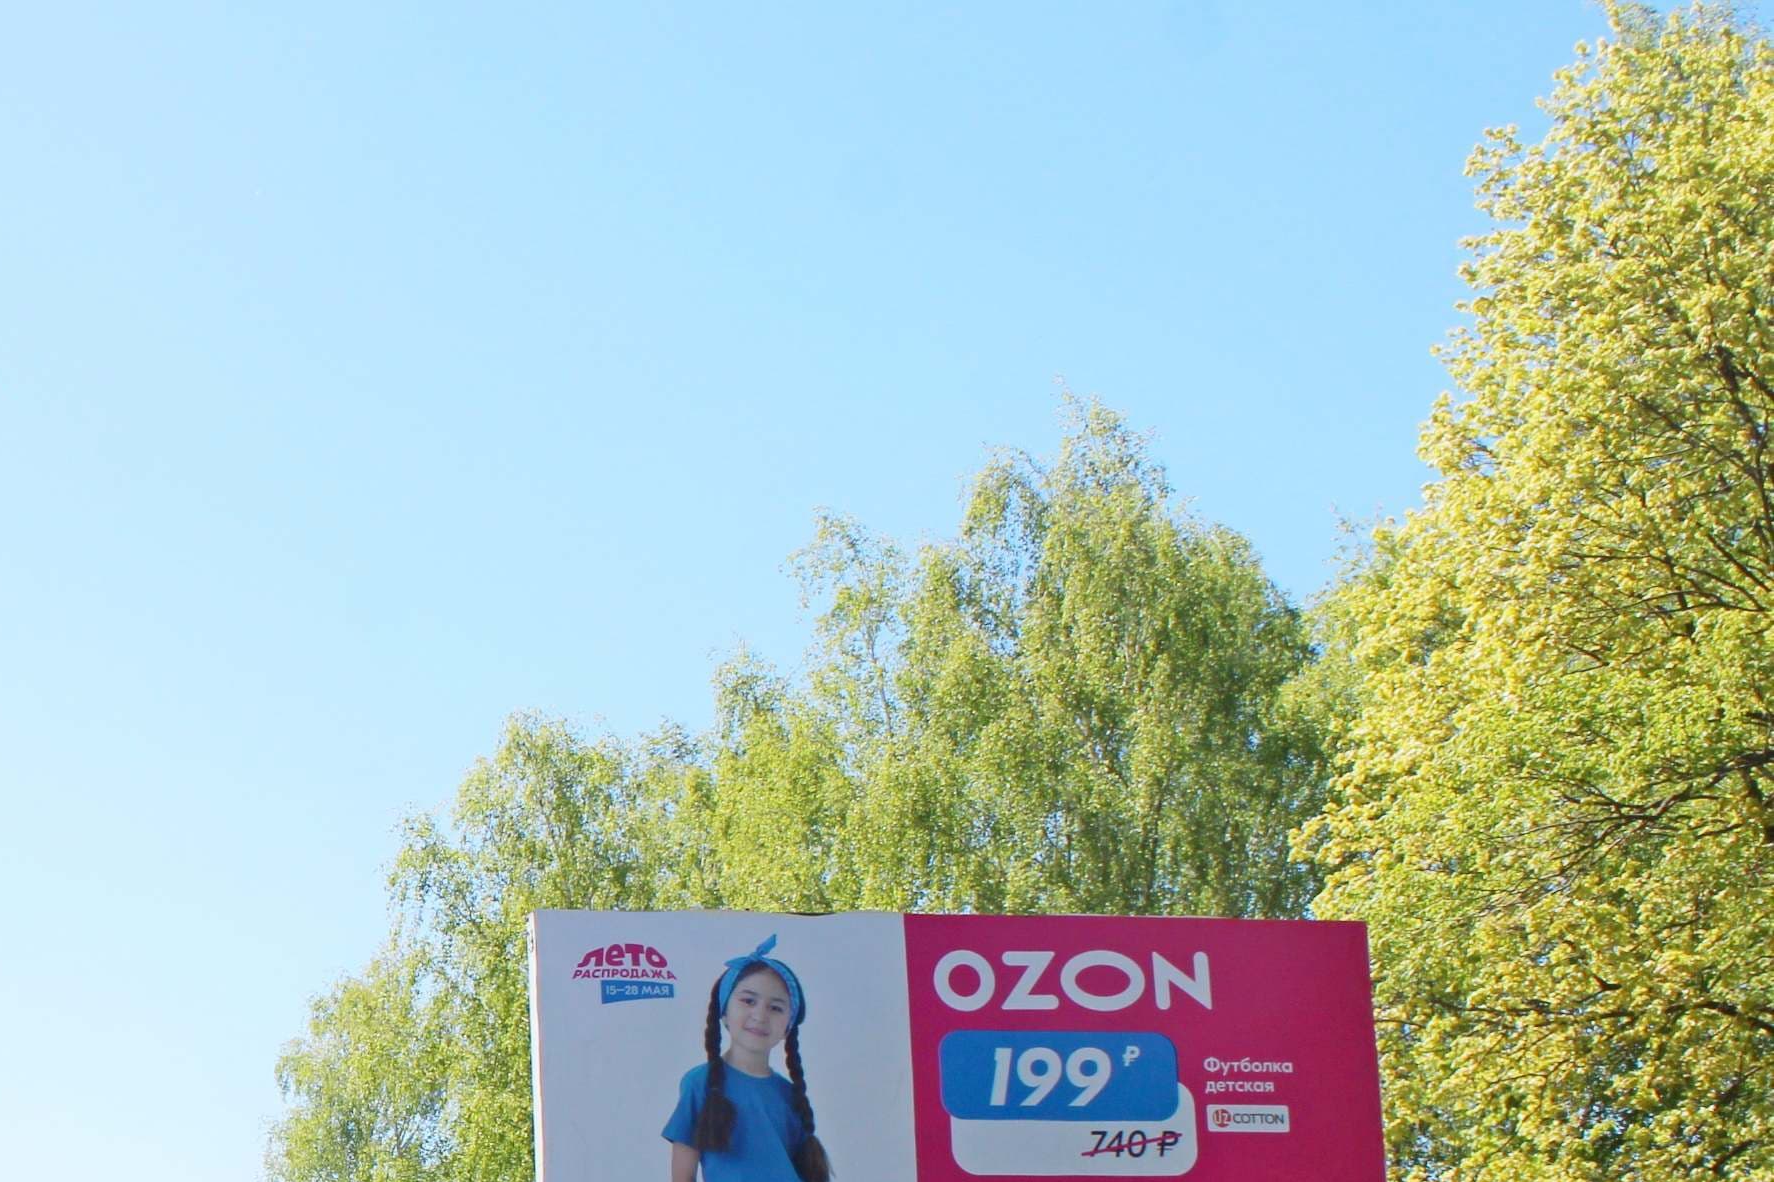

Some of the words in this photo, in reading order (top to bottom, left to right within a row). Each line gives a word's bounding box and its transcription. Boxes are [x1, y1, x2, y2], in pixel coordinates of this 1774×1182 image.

[571, 968, 678, 980] РАСПРОДАЖА
[933, 949, 1213, 1012] OZON
[641, 984, 670, 996] МАЯ
[1203, 1056, 1294, 1077] Футболка
[989, 1046, 1113, 1107] 199
[1205, 1080, 1275, 1095] детская
[1232, 1112, 1285, 1125] COTTON
[1089, 1130, 1148, 1158] 740
